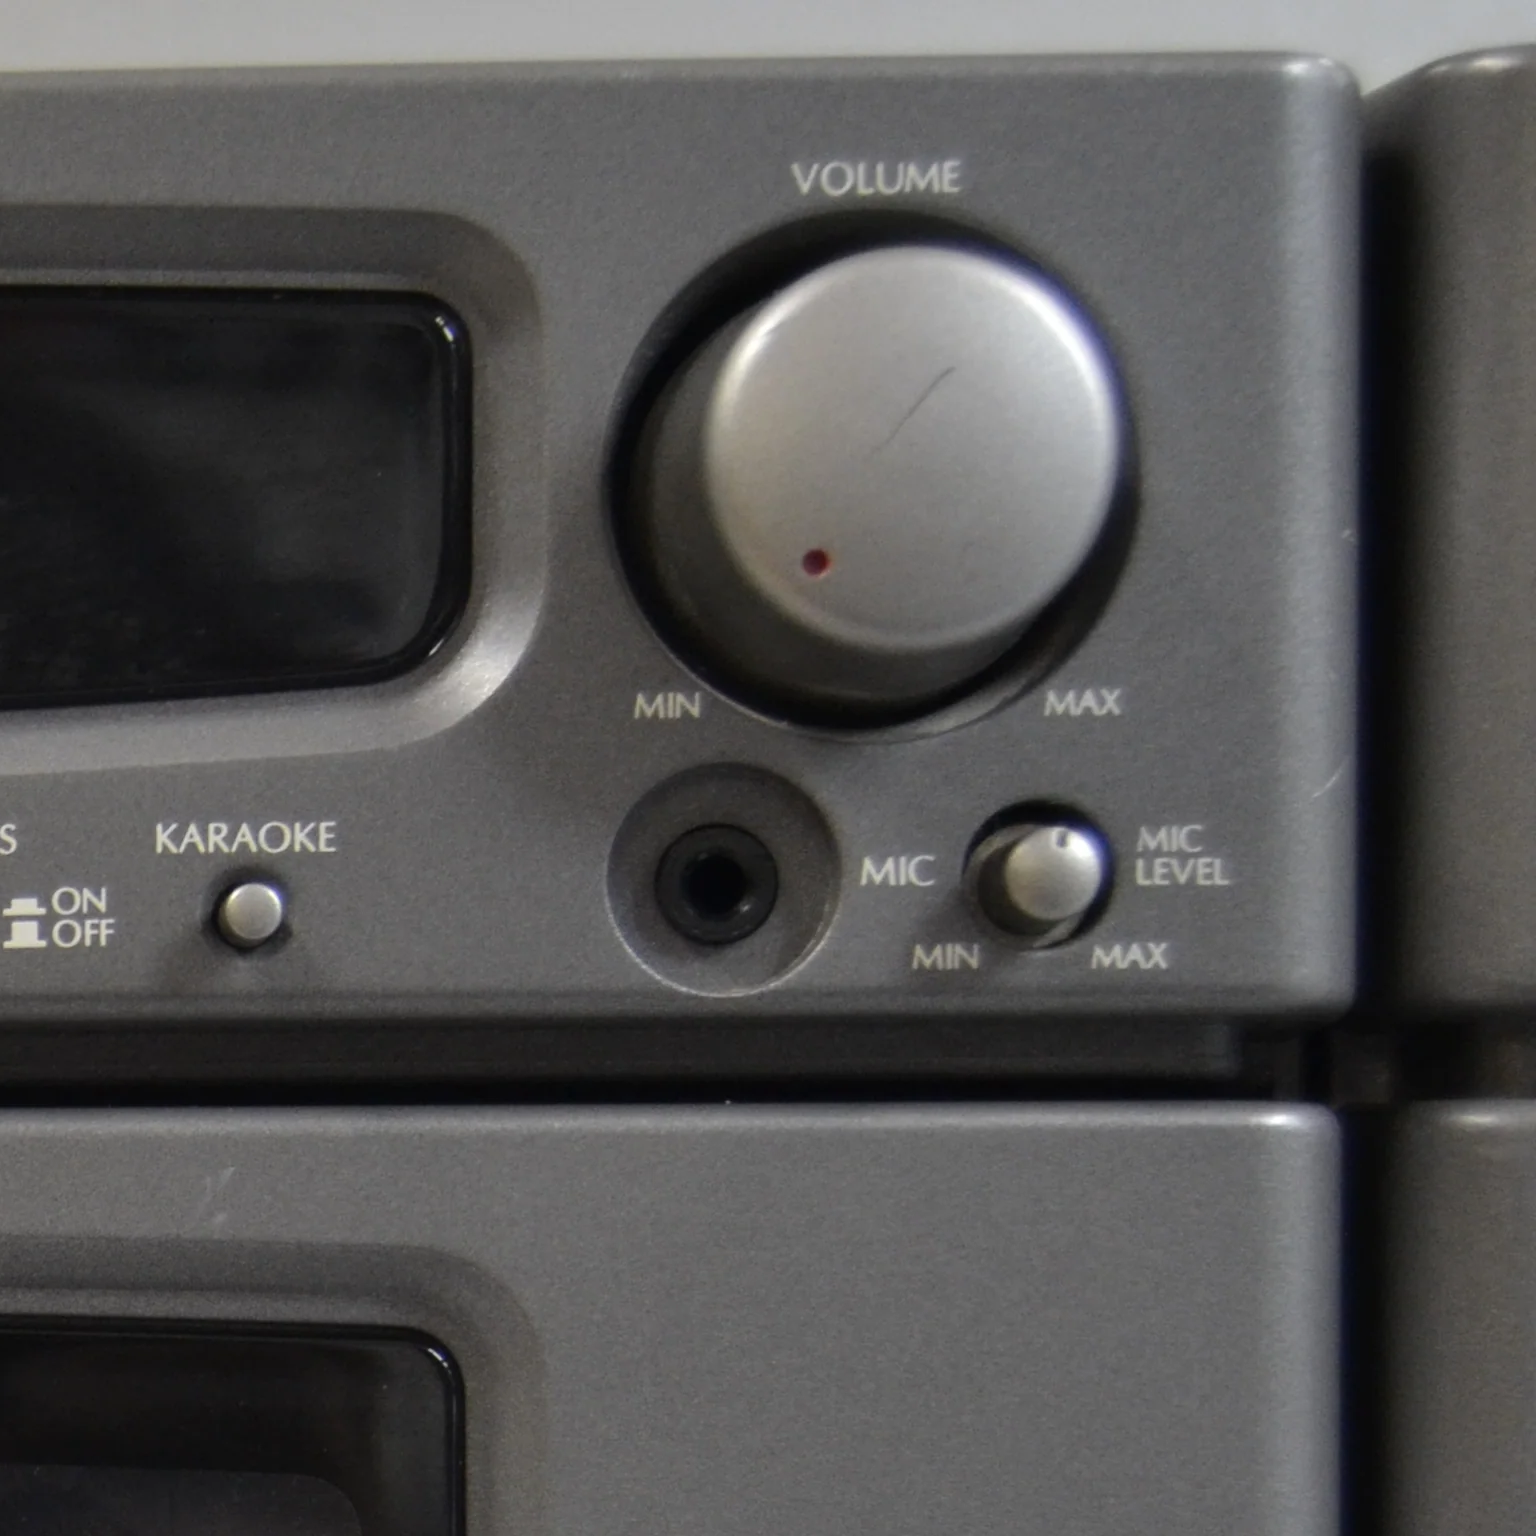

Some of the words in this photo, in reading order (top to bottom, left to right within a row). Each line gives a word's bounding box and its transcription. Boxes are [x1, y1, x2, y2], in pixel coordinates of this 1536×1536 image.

[790, 160, 962, 197] VOLUME
[633, 691, 702, 720] MIN
[1043, 688, 1122, 718] MAX
[155, 820, 337, 854] KARAOKE
[1136, 824, 1204, 853] MIC
[860, 855, 936, 887] MIC
[1135, 857, 1231, 887] LEVEL
[51, 886, 107, 916] ON
[51, 918, 116, 948] OFF
[911, 943, 980, 971] MIN
[1090, 942, 1169, 971] MAX
